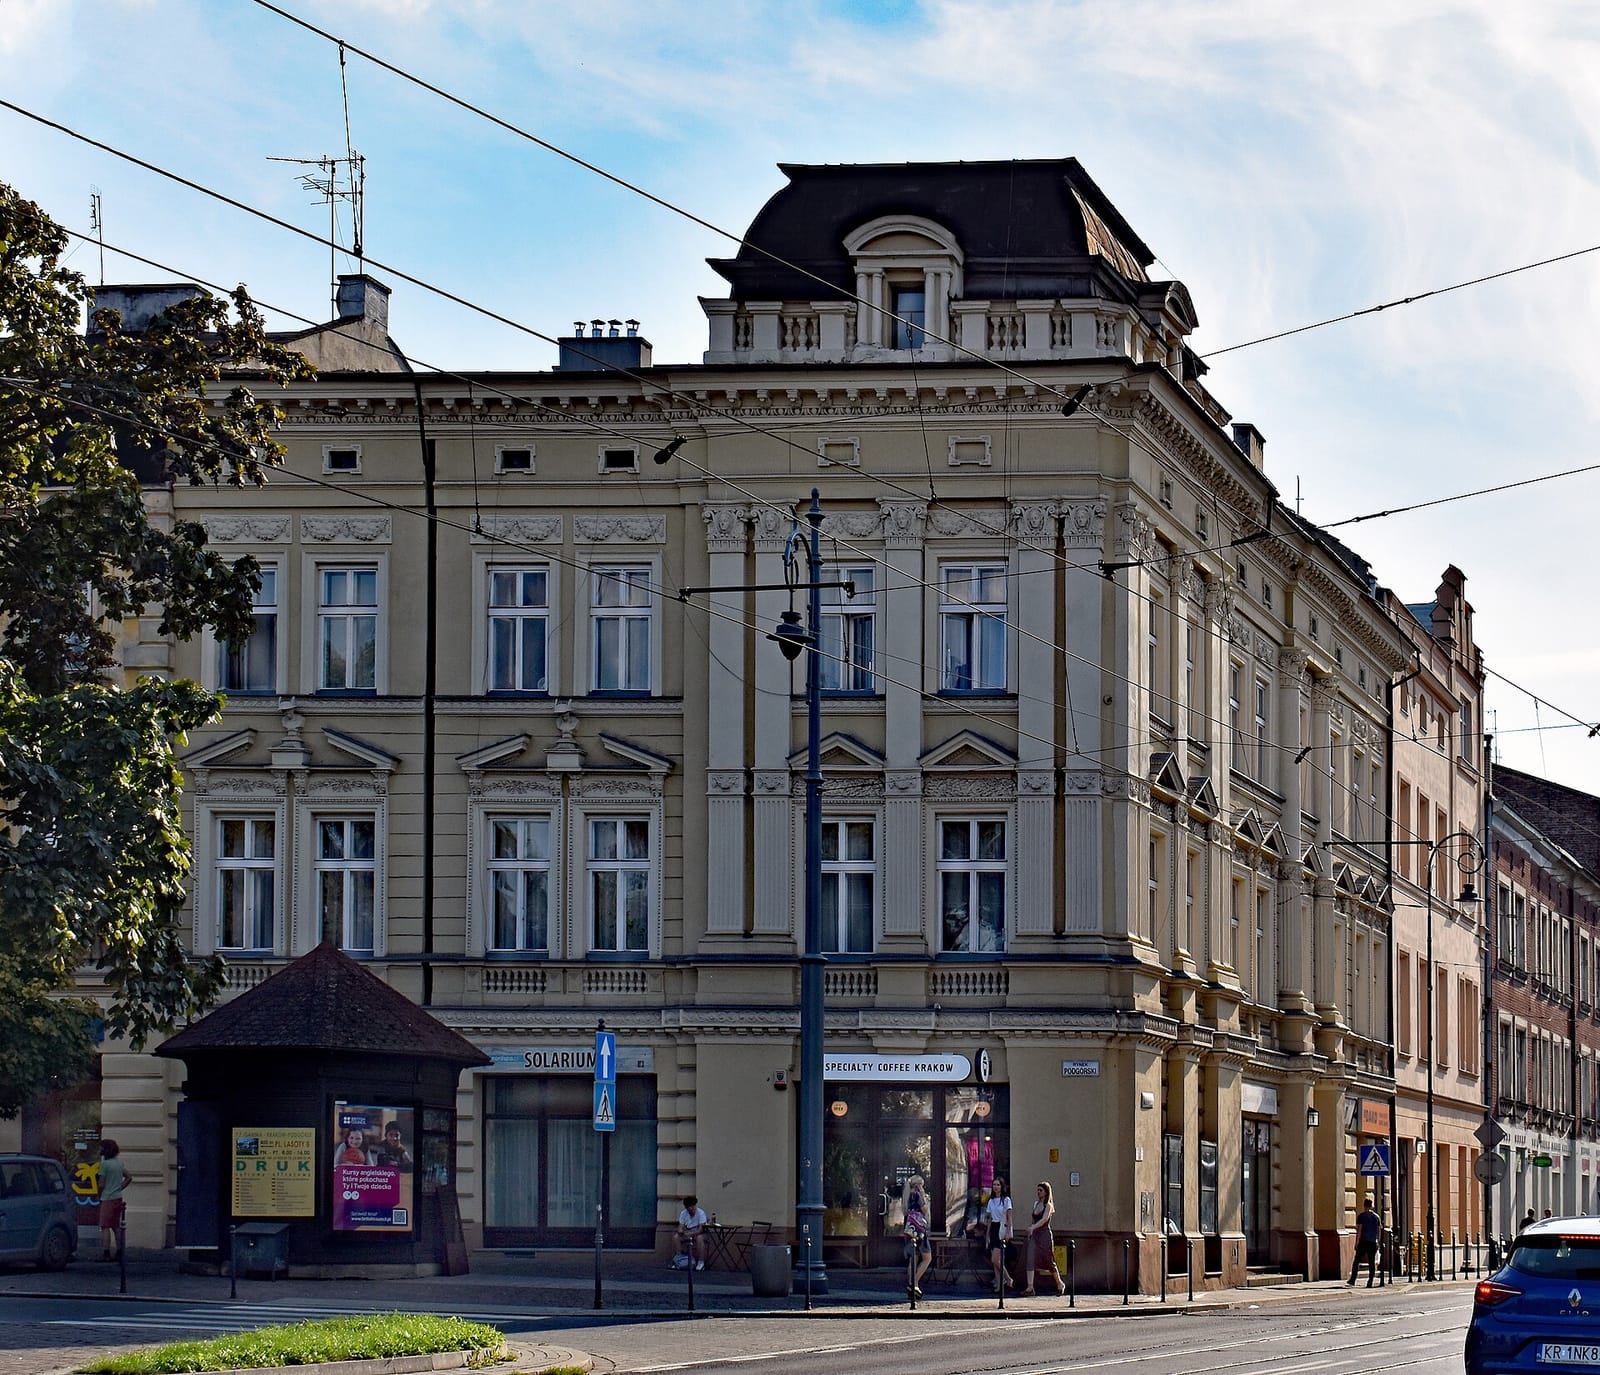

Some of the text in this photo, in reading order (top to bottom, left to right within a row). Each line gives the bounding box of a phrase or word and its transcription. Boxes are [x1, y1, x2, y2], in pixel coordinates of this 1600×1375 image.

[524, 1052, 596, 1068] SOLARIUM
[825, 1062, 954, 1072] SPECIALTY COFFEE KRAKOW
[236, 1160, 310, 1171] DRUK
[1544, 1345, 1600, 1361] KR 1NK8
